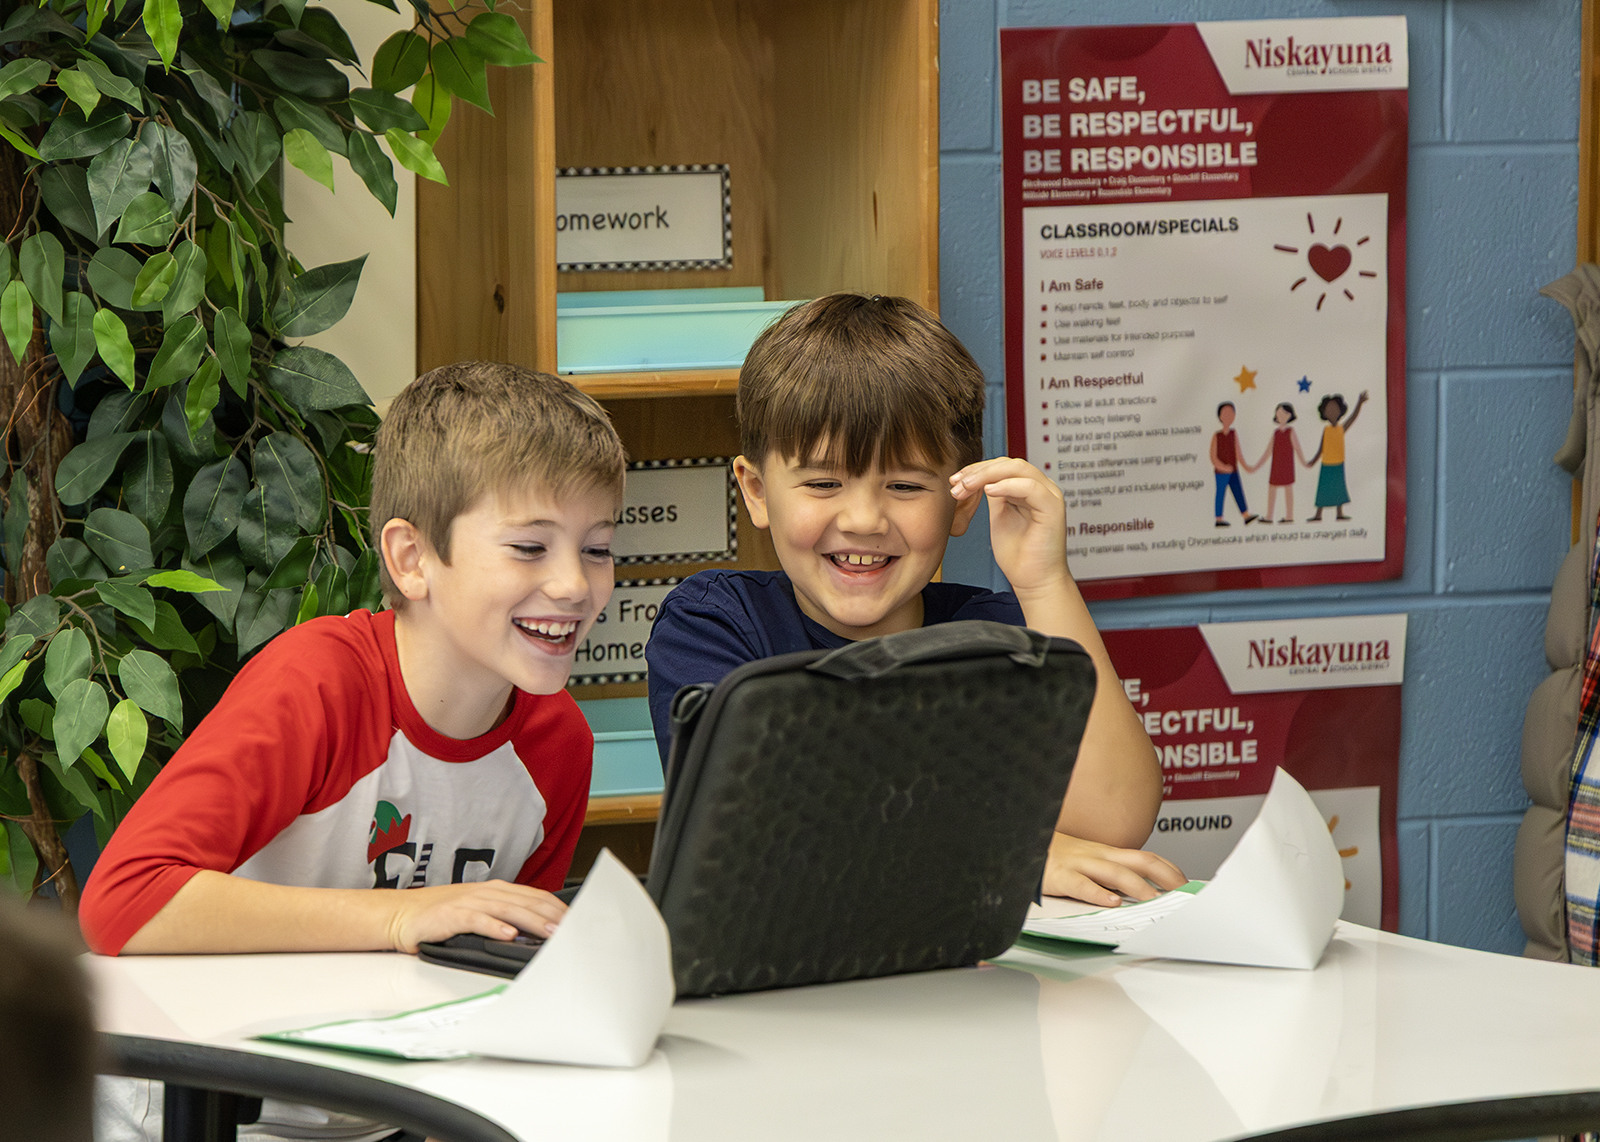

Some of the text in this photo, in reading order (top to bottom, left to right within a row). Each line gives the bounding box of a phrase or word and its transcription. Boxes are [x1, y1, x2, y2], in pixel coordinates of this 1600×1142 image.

[1245, 36, 1393, 74] Niskayuna
[1022, 75, 1146, 105] BE SAFE,
[1022, 107, 1254, 139] BE RESPECTFUL,
[1023, 141, 1258, 174] BE RESPONSIBLE
[556, 204, 670, 231] omework
[1040, 216, 1240, 239] CLASSROOM/SPECIALS
[1040, 248, 1063, 259] VOICE
[1066, 247, 1095, 258] LEVELS
[1041, 277, 1104, 293] I Am Safe
[1072, 317, 1103, 329] walking
[1041, 372, 1144, 390] I Am Respectful
[1055, 399, 1082, 409] Follow
[1118, 396, 1157, 406] directions
[1056, 413, 1141, 426] Whole body listening
[1057, 433, 1073, 443] Use
[1075, 431, 1093, 441] kind
[1095, 431, 1111, 440] and
[1113, 429, 1144, 441] positive
[1080, 518, 1154, 536] Responsible
[619, 598, 659, 622] Fro
[575, 638, 644, 662] Home
[1247, 635, 1391, 673] Niskayuna
[1156, 814, 1233, 832] GROUND
